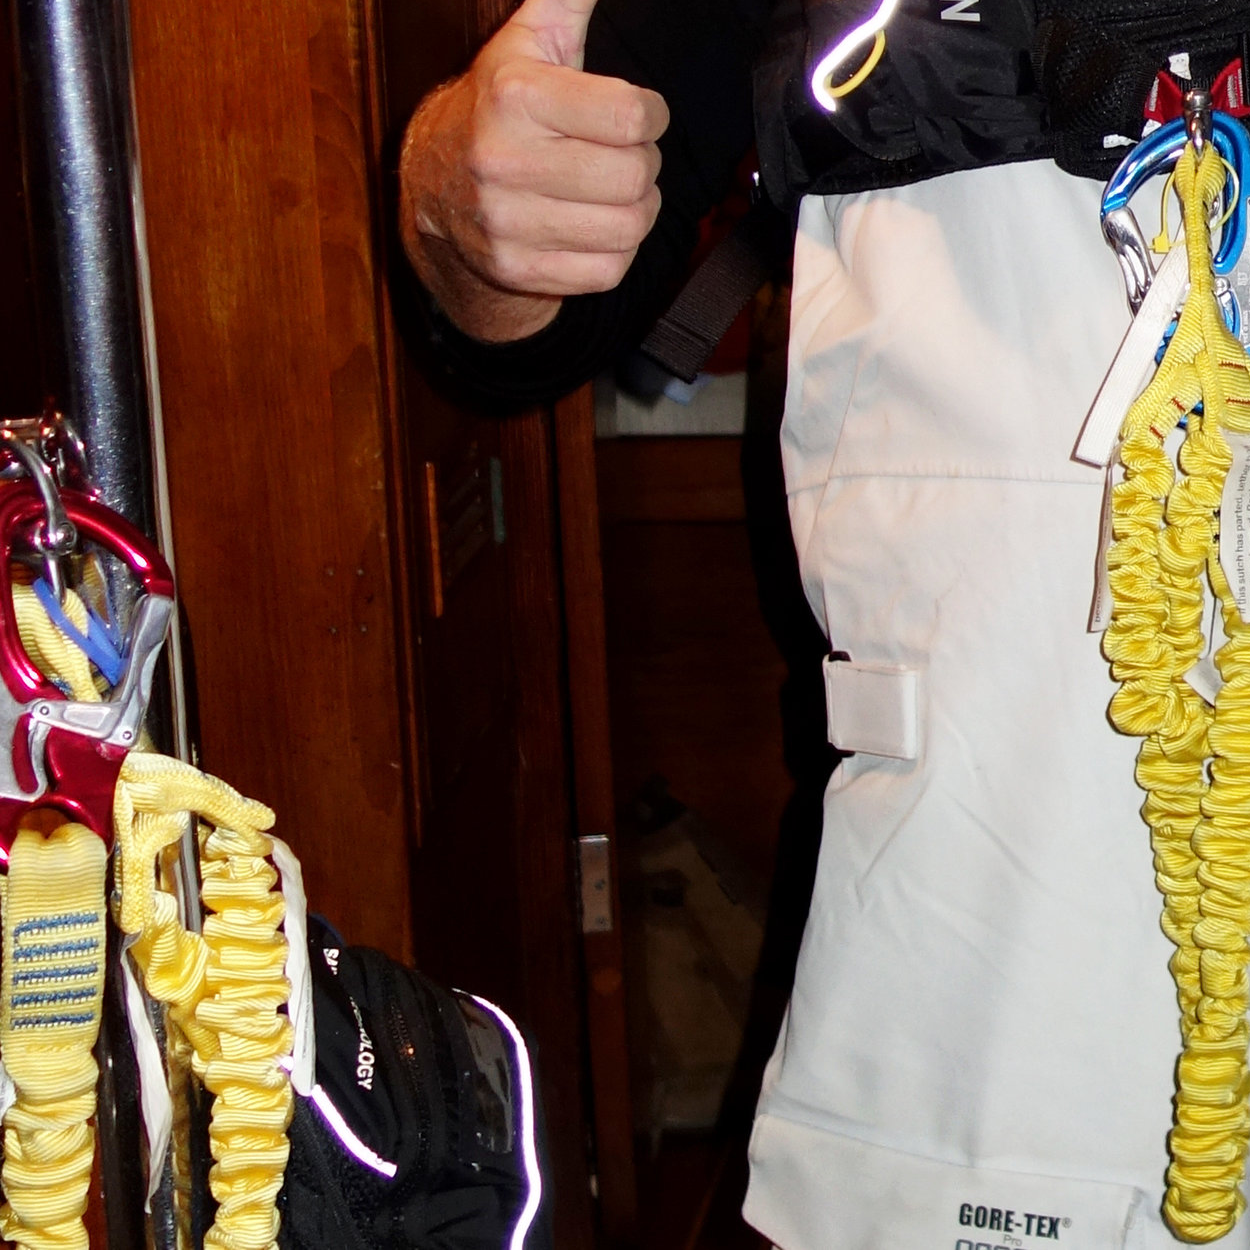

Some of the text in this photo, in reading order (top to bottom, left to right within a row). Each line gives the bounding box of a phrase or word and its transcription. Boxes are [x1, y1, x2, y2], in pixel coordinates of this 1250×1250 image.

[1234, 534, 1244, 552] has
[1237, 587, 1246, 605] this
[959, 1203, 1060, 1240] GORE-TEX
[1003, 1234, 1022, 1247] Pro
